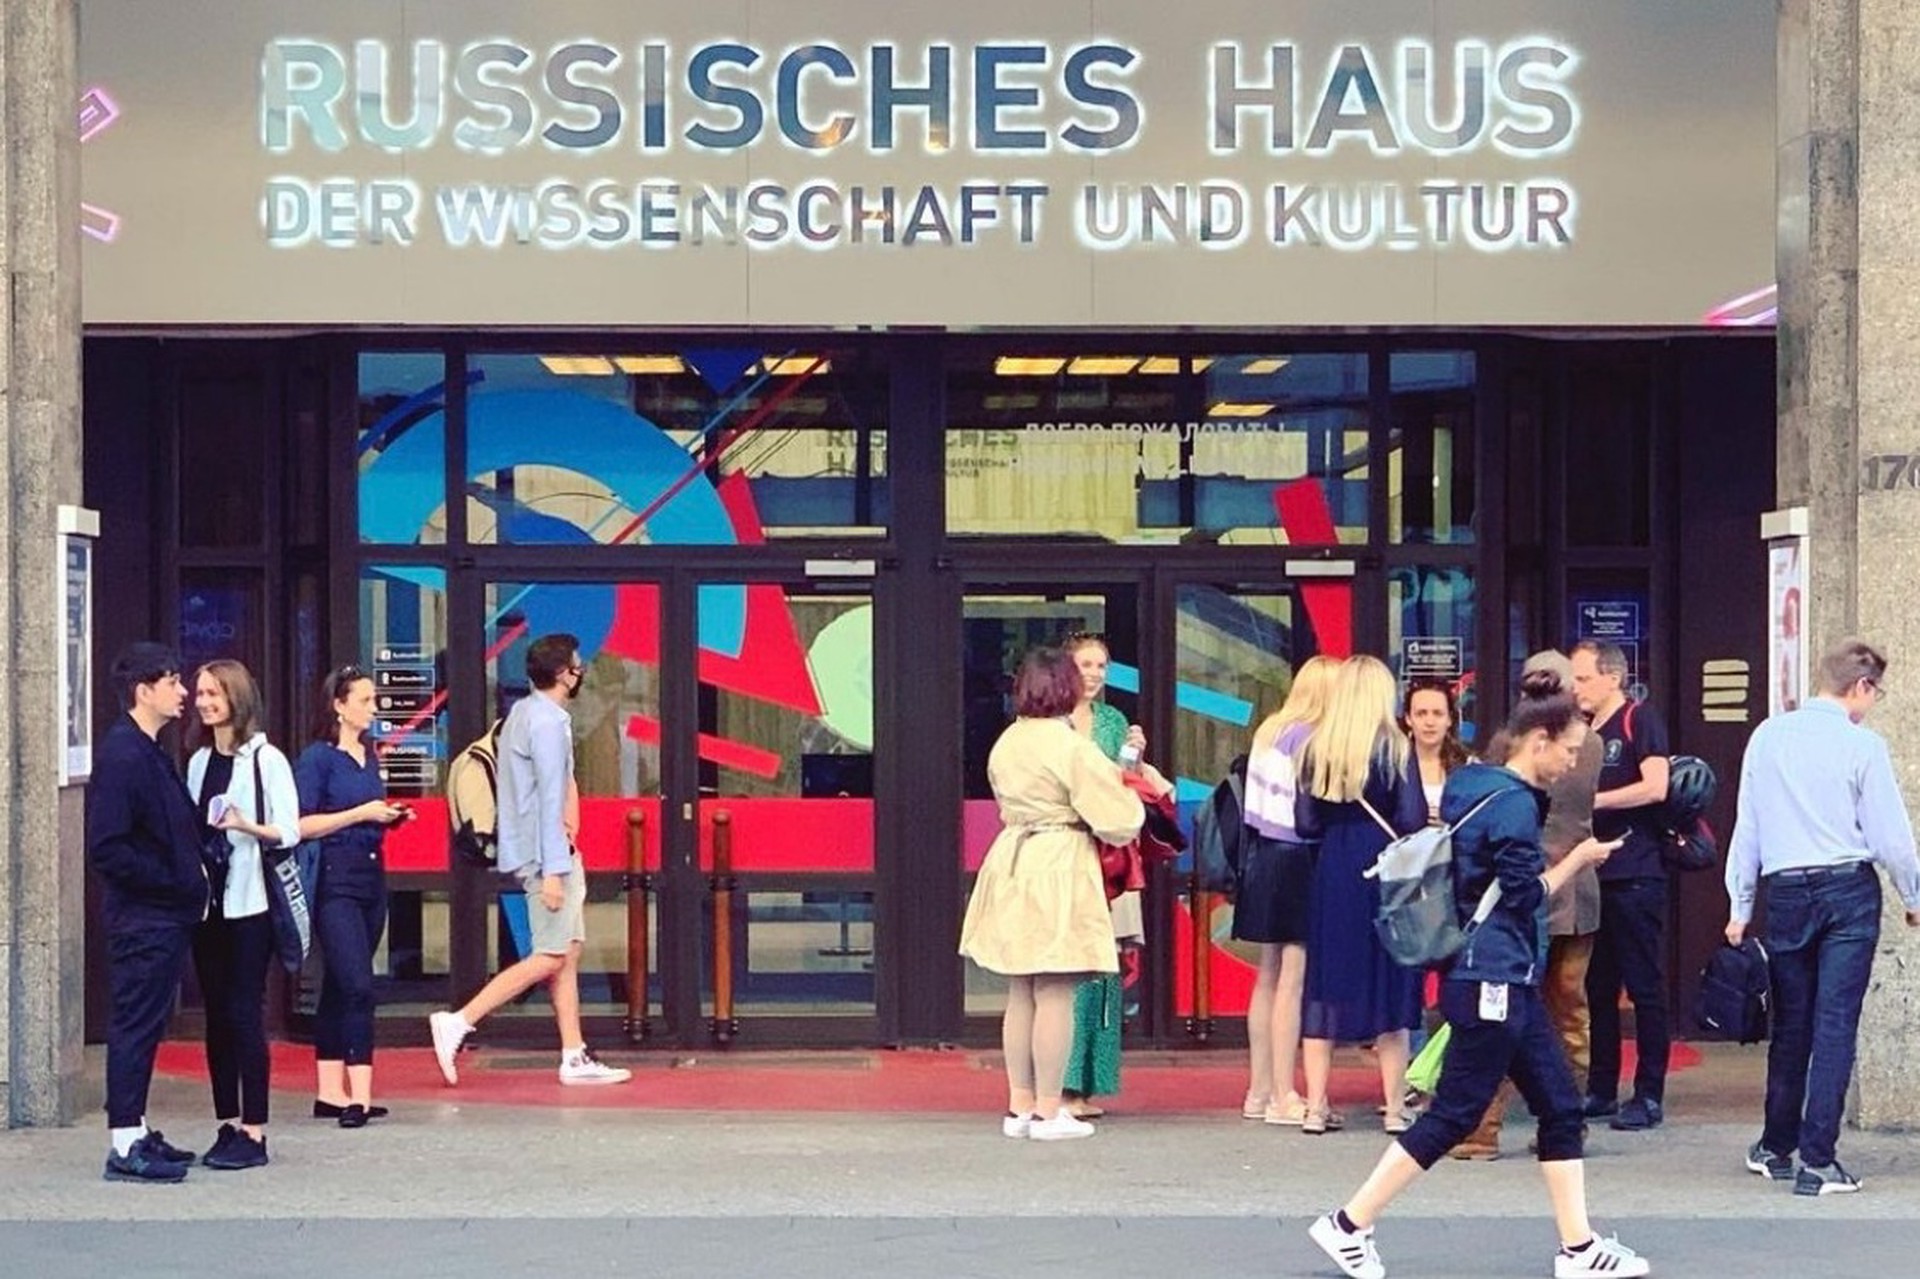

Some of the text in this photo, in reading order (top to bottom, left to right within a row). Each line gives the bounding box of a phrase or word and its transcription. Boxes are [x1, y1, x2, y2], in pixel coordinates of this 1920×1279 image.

[263, 42, 1575, 151] RUSSISCHES HAUS
[265, 181, 1571, 247] DER WISSENSCHAFT UND KULTUR
